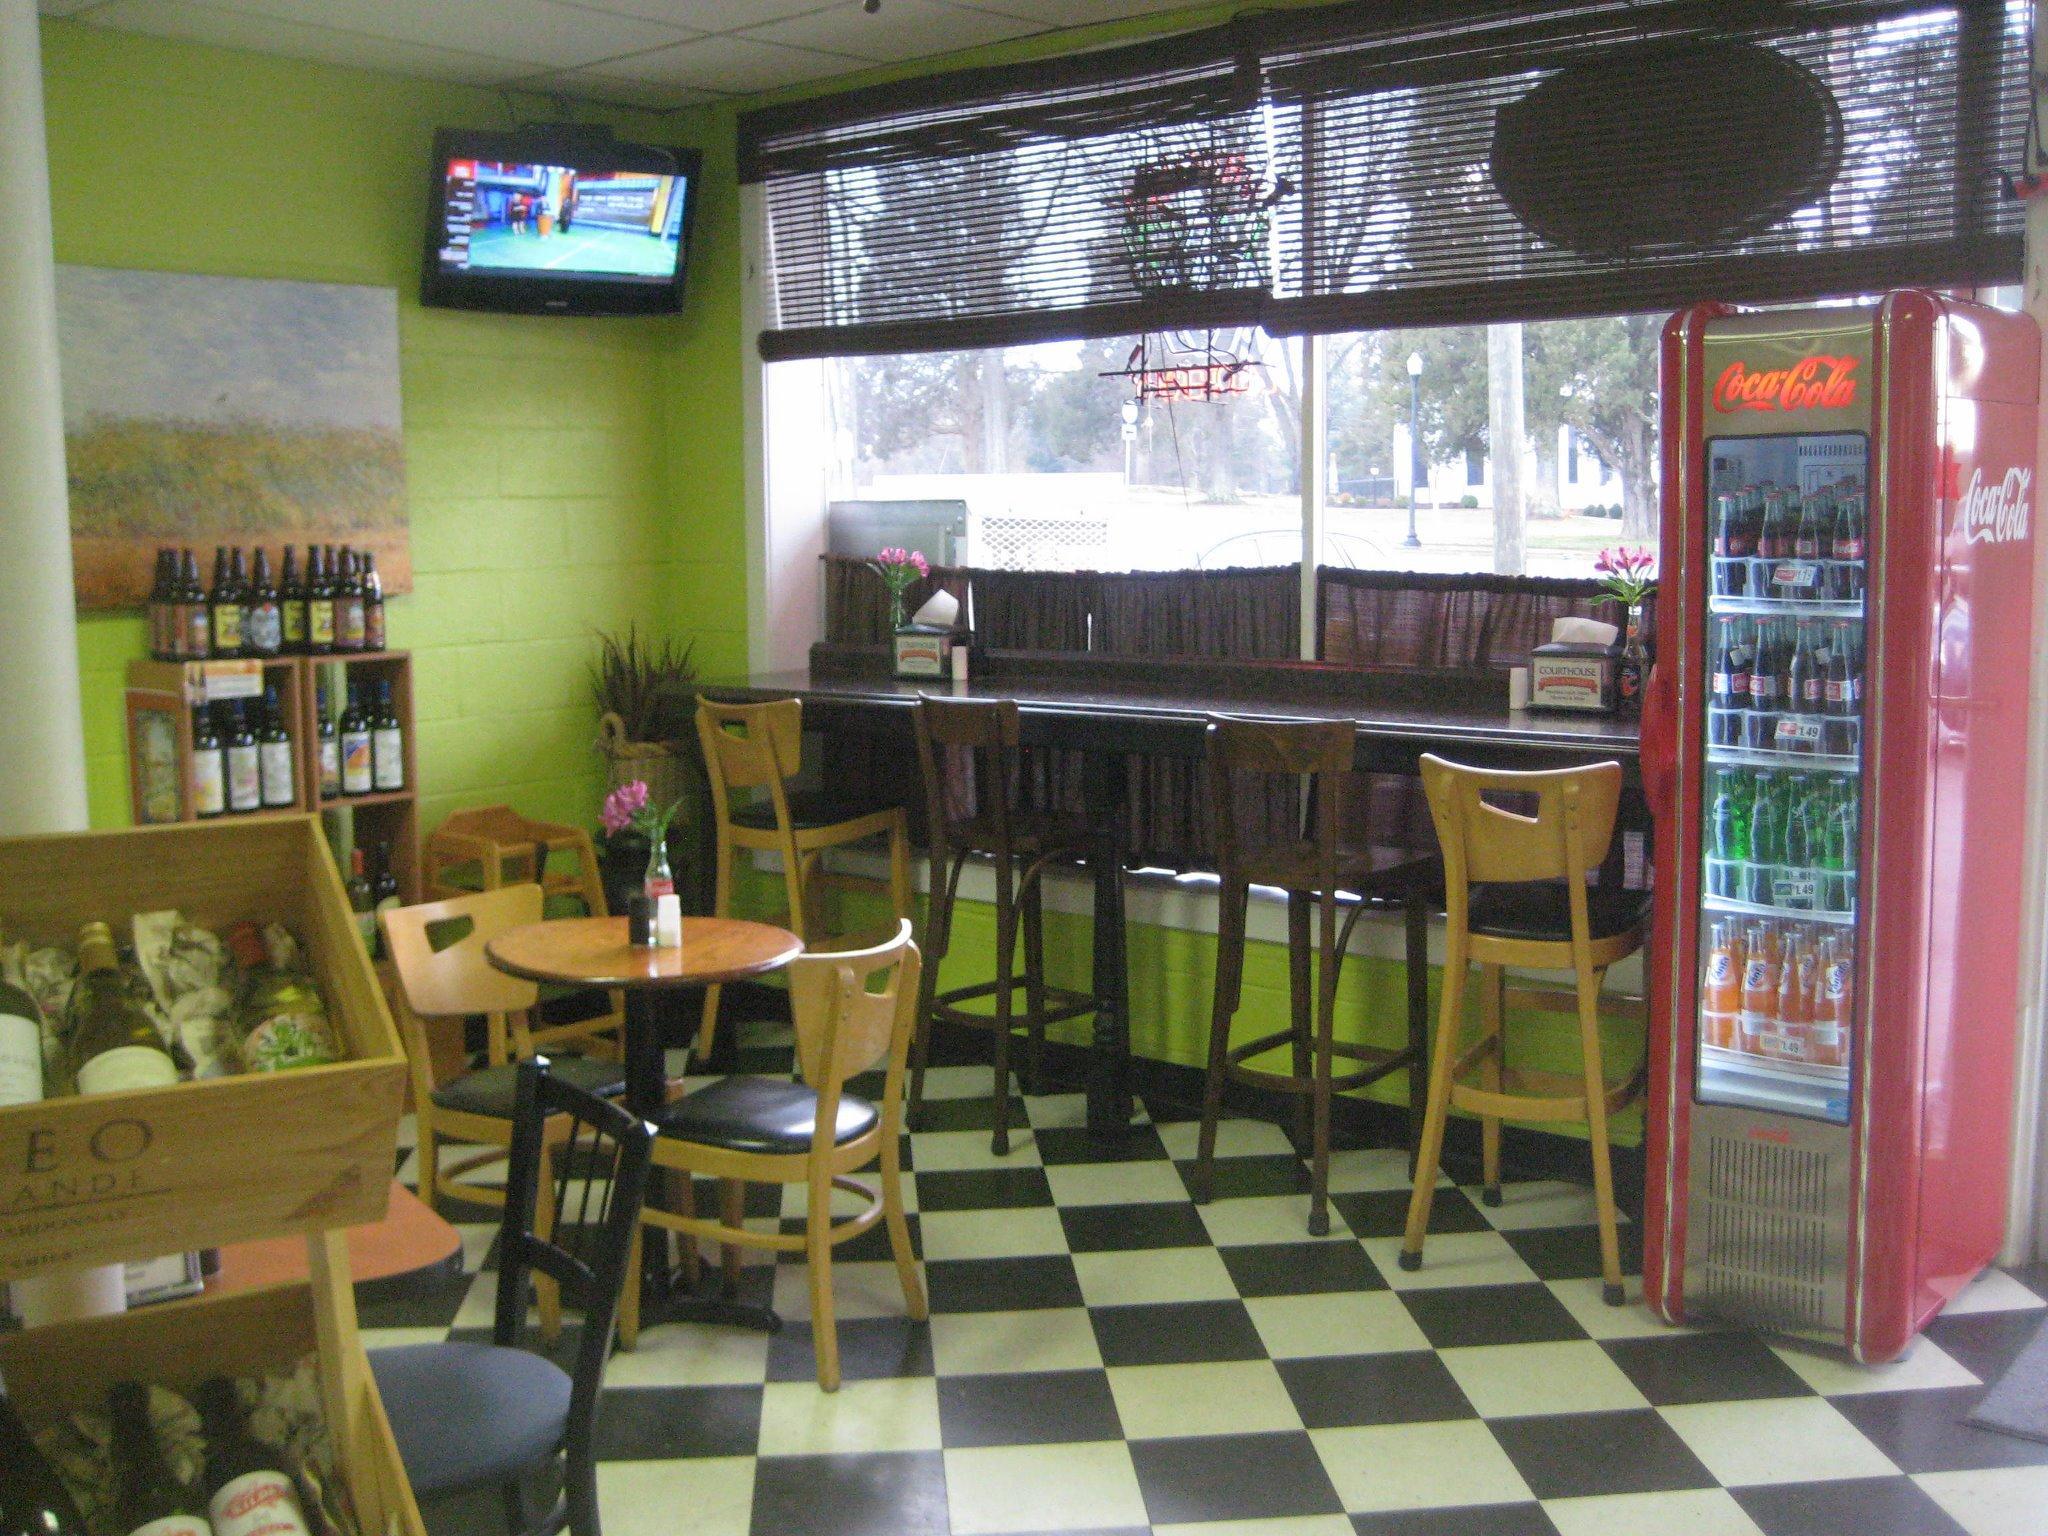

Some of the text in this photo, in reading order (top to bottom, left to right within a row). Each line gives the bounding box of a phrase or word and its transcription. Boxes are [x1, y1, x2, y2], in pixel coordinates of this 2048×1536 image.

[1713, 354, 1861, 413] Coca-Cola
[1964, 467, 2031, 544] Coca-Cola
[1539, 666, 1597, 677] COURTHOUSE
[1796, 884, 1814, 895] 1.49
